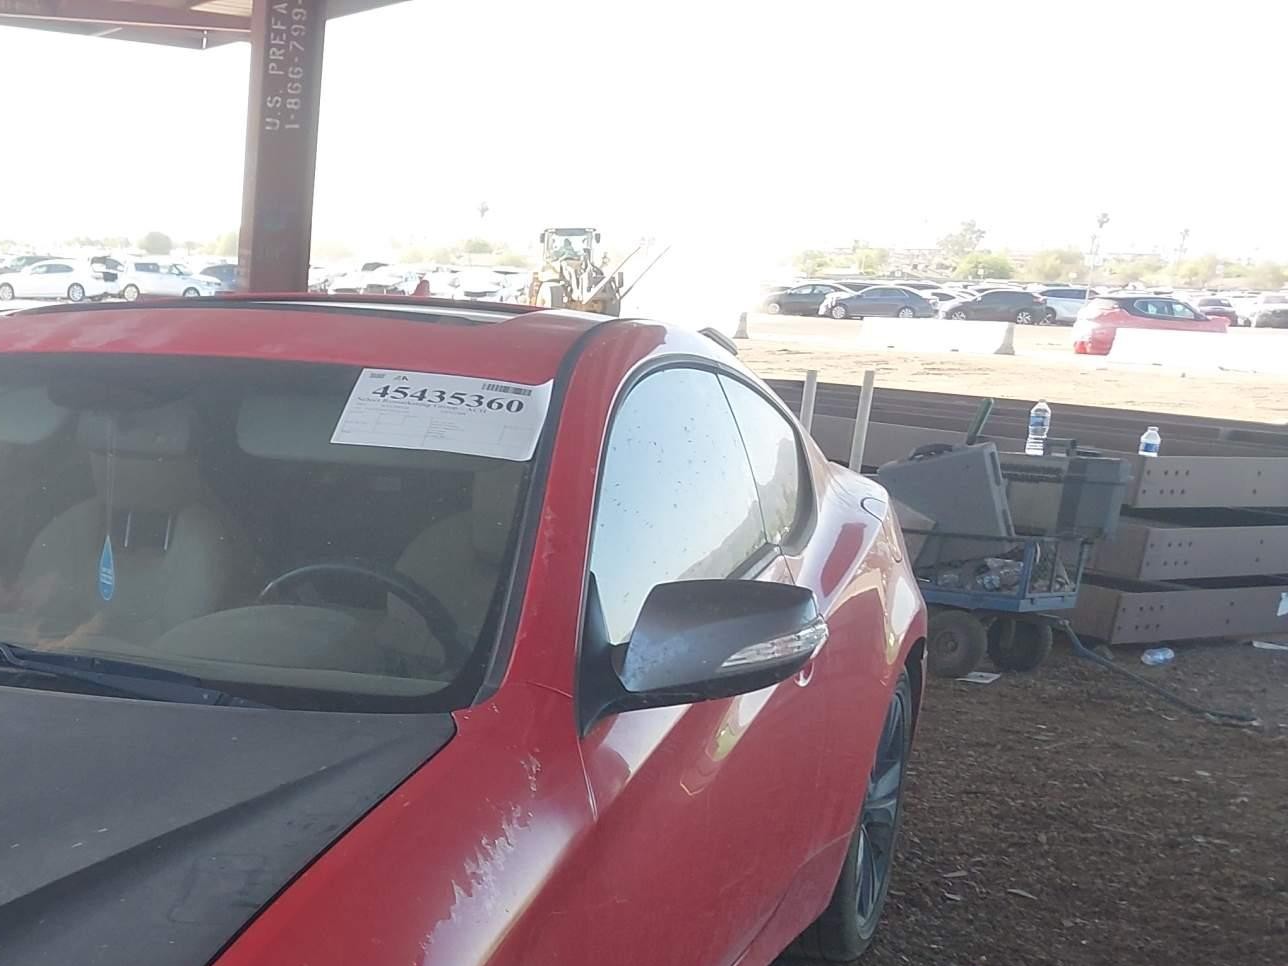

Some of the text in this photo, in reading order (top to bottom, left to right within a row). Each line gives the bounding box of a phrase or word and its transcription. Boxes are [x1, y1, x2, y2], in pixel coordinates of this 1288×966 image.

[265, 0, 288, 131] U.S. PREFA
[372, 385, 524, 413] 45435360
